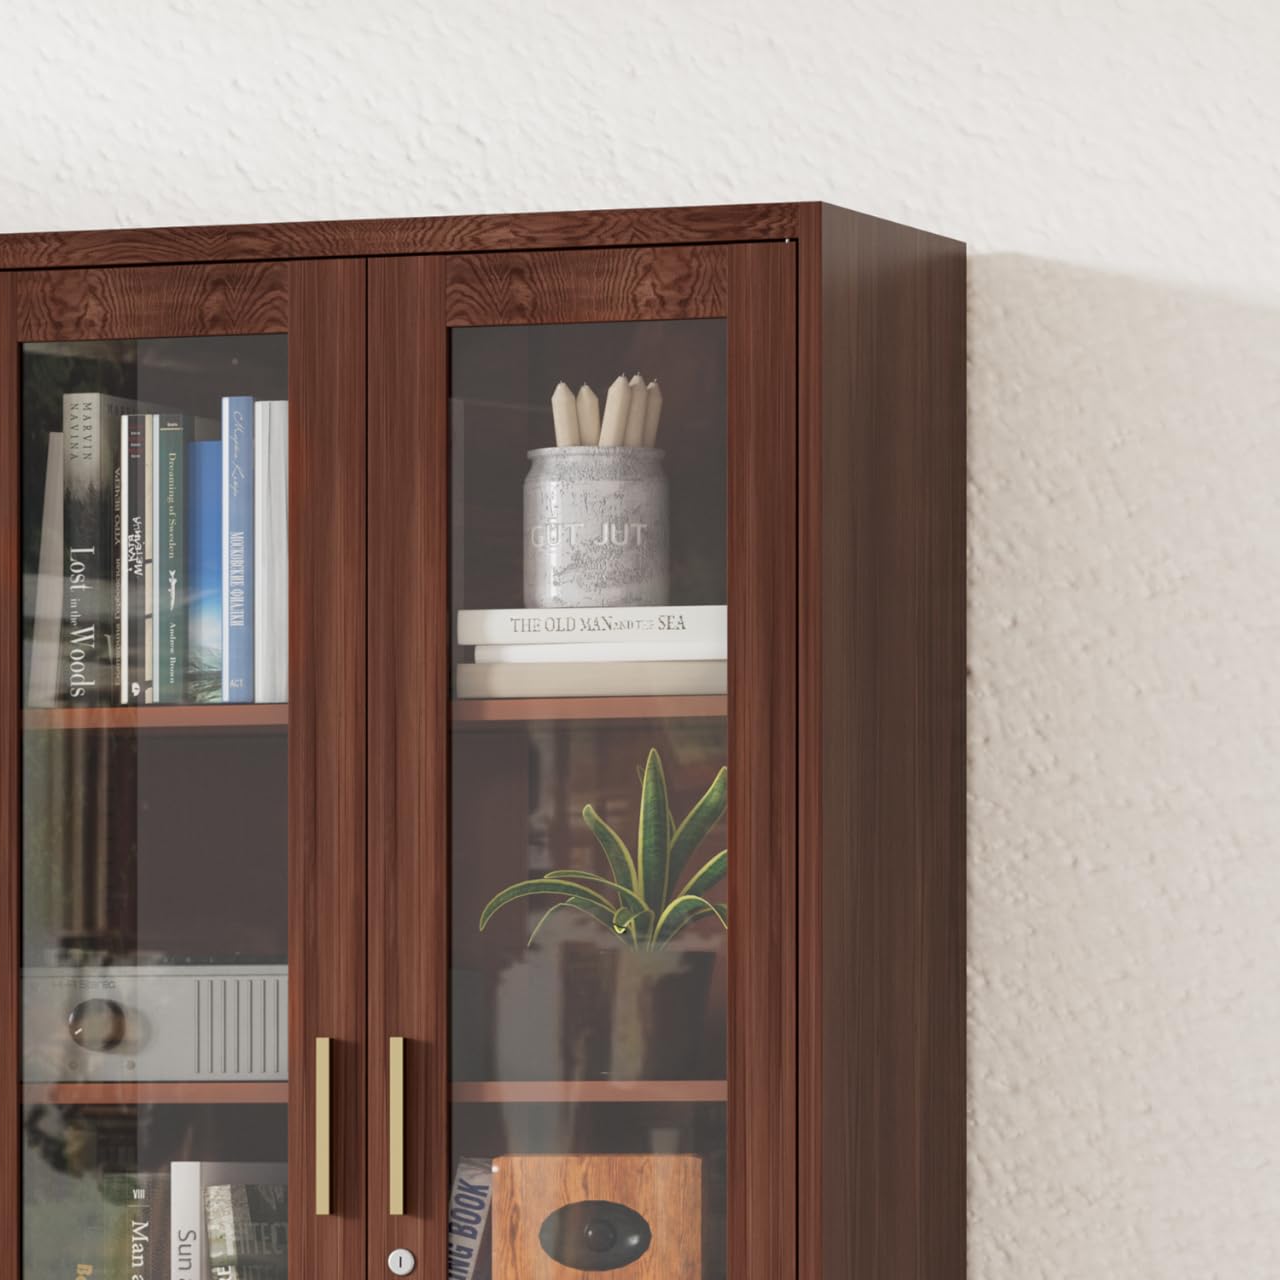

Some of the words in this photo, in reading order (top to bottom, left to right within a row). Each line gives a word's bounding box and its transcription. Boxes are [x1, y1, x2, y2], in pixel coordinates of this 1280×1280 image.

[70, 402, 79, 461] NAVINA
[83, 402, 93, 461] MARVIN
[168, 452, 177, 504] Dreaming
[168, 505, 177, 517] of
[168, 518, 177, 559] Sweden
[70, 546, 95, 590] Lost
[70, 598, 80, 609] in
[511, 616, 540, 633] THE
[545, 616, 576, 633] OLD
[580, 615, 614, 632] MAN
[658, 615, 686, 632] SEA
[70, 624, 95, 697] Woods
[449, 1178, 490, 1241] BOOK
[131, 1221, 150, 1268] Man
[178, 1230, 197, 1271] Sun
